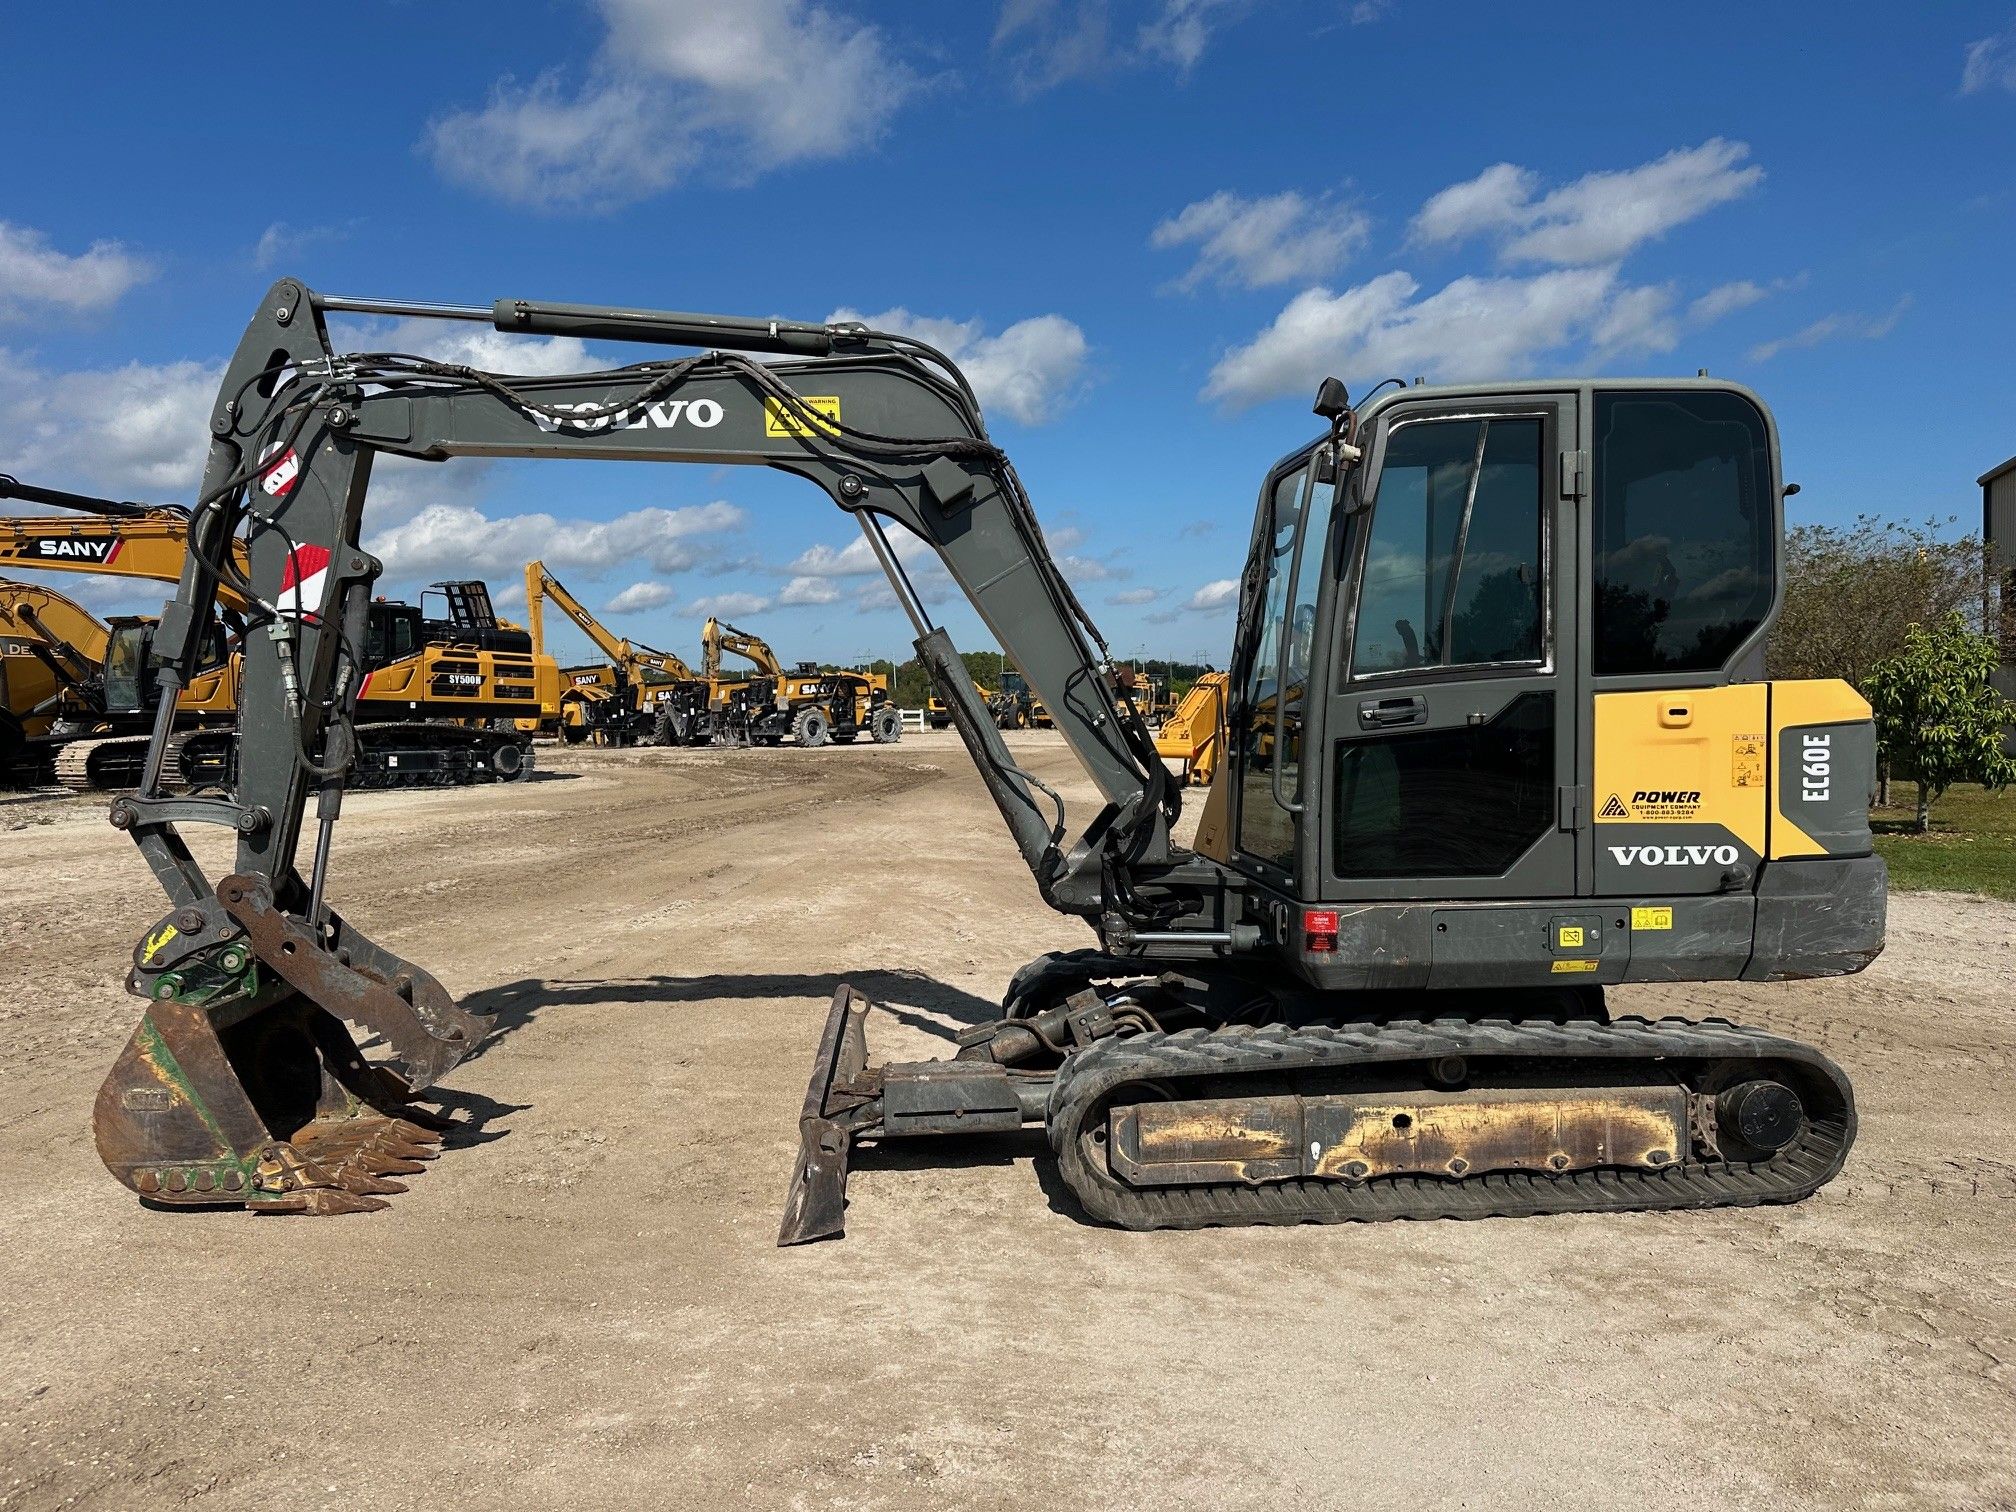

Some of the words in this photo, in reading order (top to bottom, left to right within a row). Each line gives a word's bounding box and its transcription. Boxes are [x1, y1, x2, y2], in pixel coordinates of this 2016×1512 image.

[39, 540, 107, 557] SANY
[9, 643, 61, 655] DEE
[449, 674, 482, 685] SY500H
[575, 674, 597, 685] SANY
[1802, 734, 1831, 802] EC60E
[1631, 791, 1701, 804] POWER
[1607, 845, 1739, 866] VOLVO
